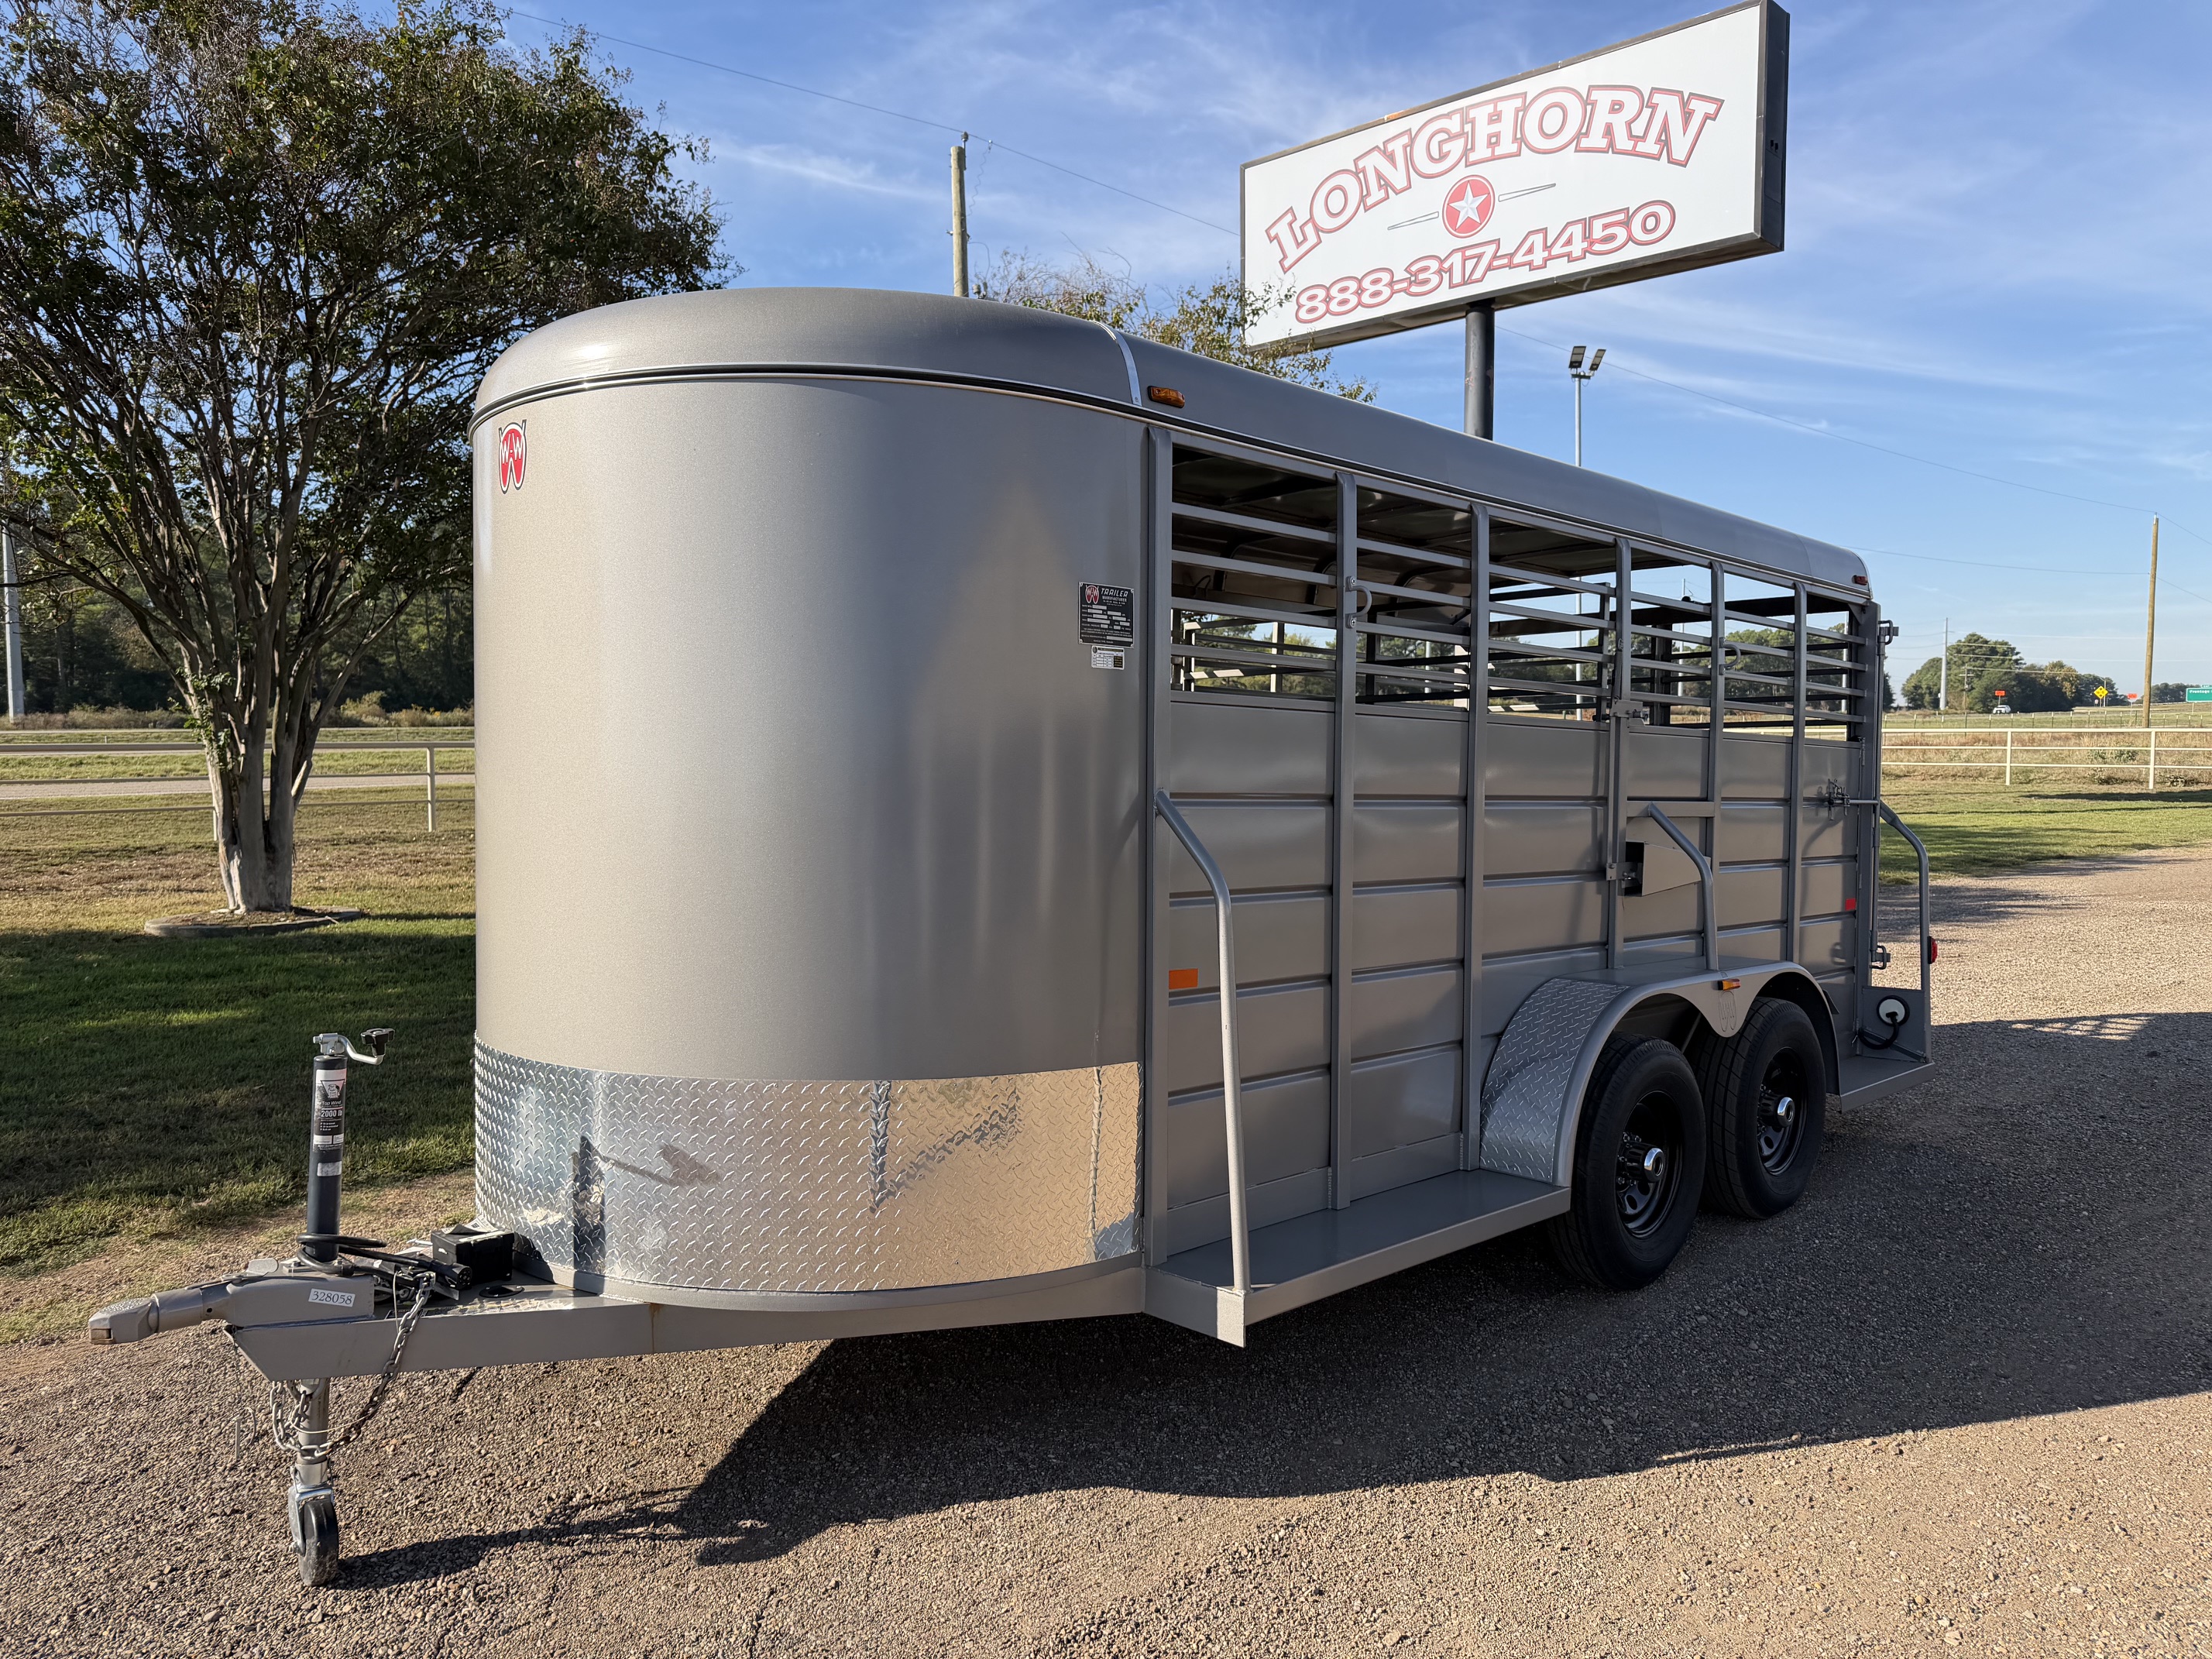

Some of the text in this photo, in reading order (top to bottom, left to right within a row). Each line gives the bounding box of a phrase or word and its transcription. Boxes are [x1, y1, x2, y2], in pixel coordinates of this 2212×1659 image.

[1266, 84, 1725, 273] LONGHORN
[1295, 200, 1677, 324] 888-317-4450
[1101, 588, 1128, 598] TRAILER
[311, 1290, 352, 1305] 328058
